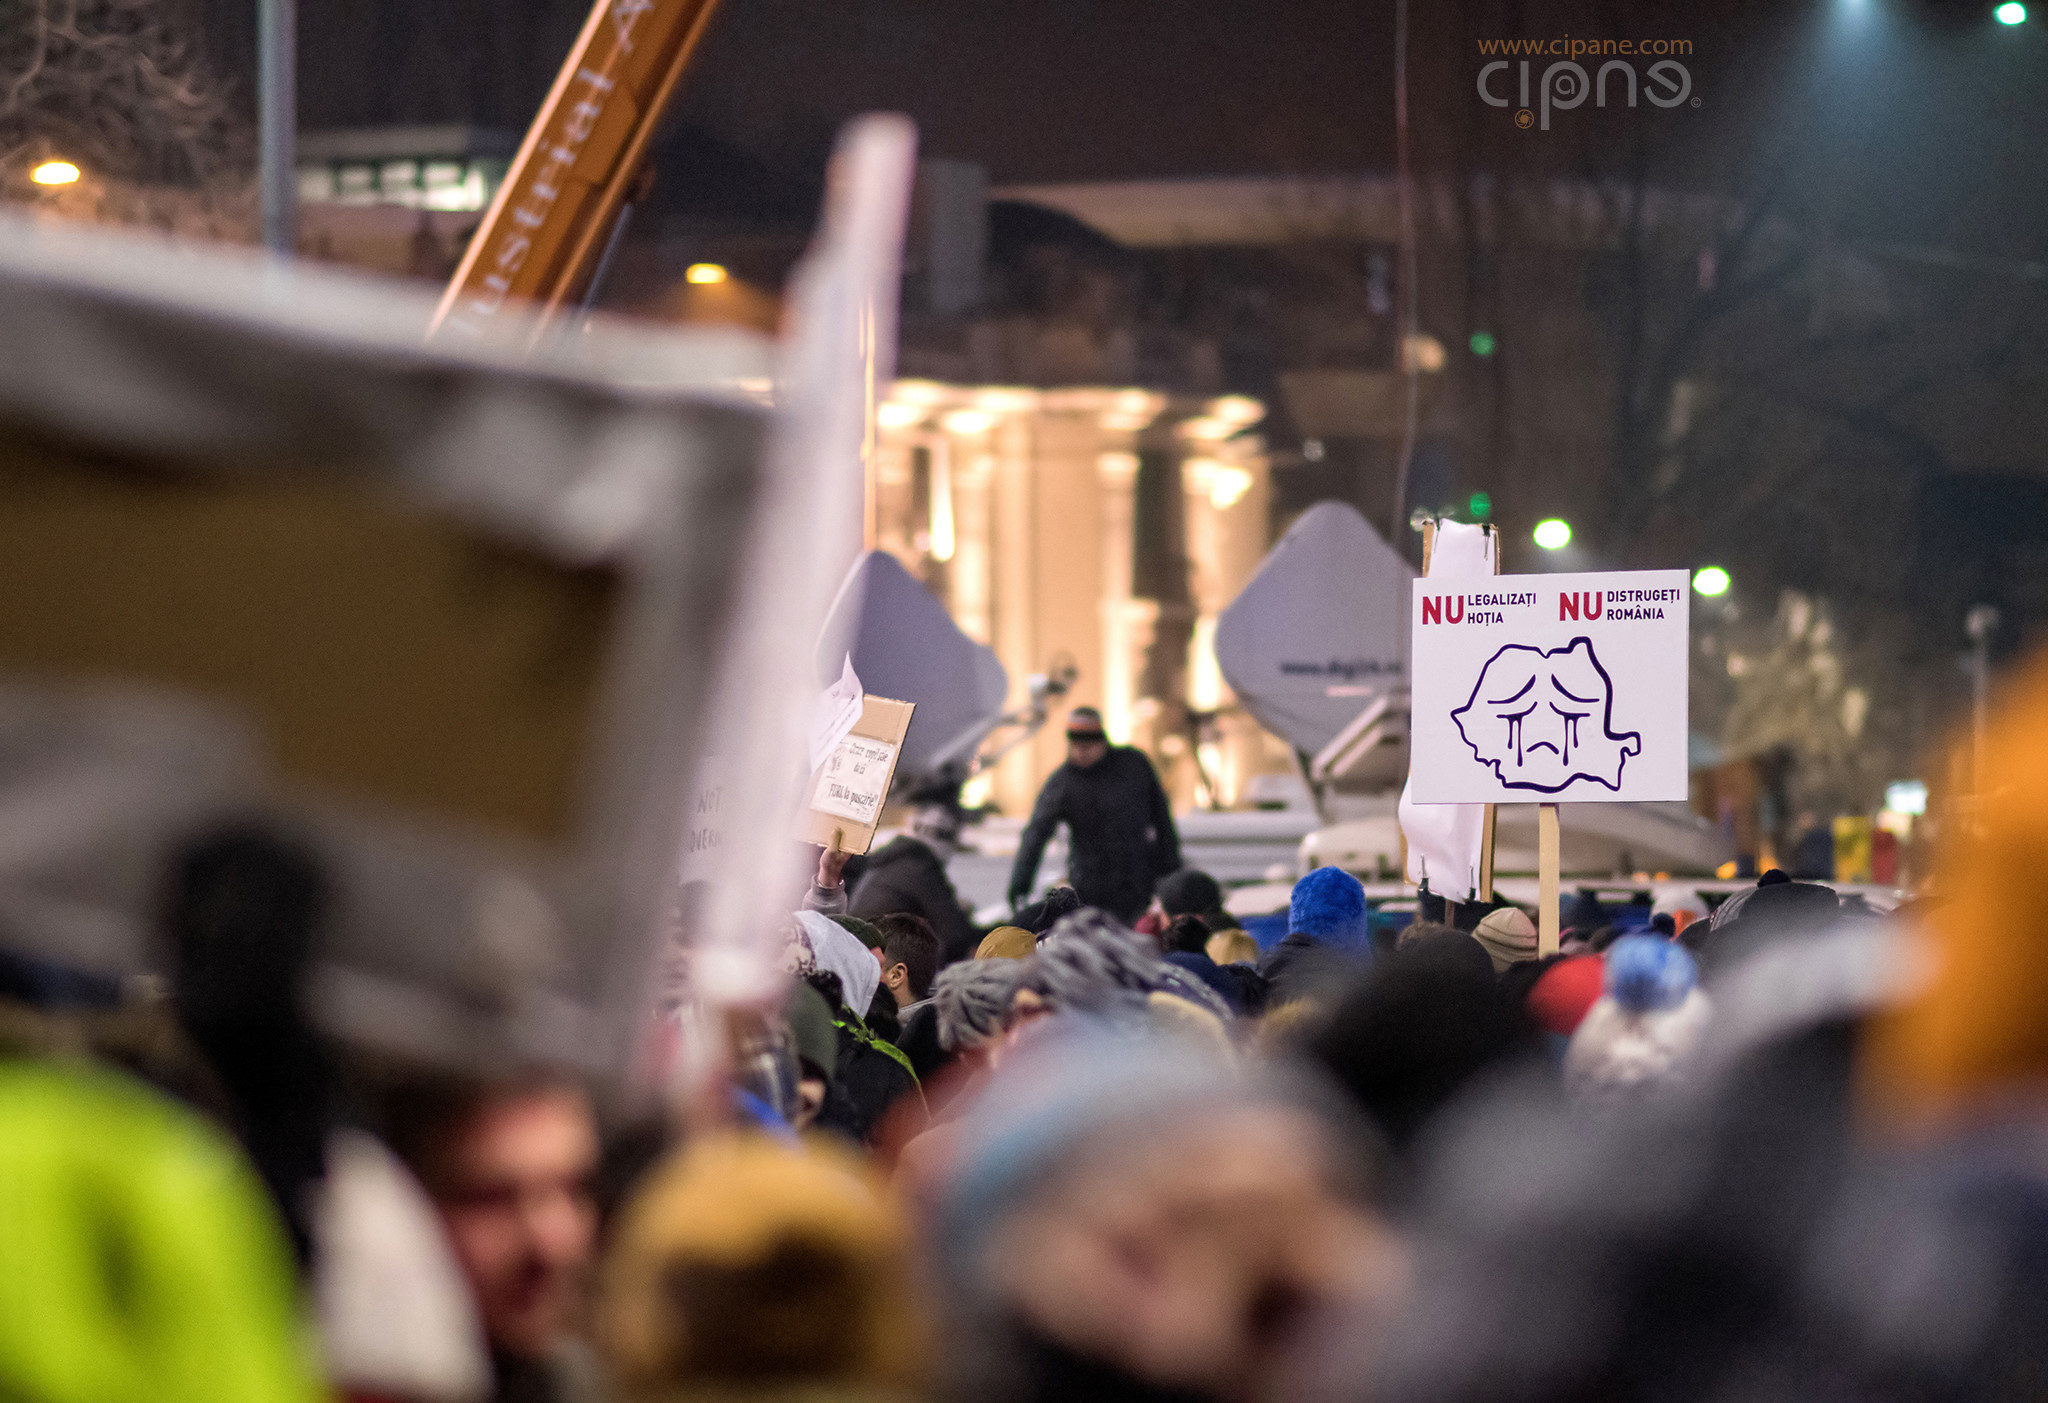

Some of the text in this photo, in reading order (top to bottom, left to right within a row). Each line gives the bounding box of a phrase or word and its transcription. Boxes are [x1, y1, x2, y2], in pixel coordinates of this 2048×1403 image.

[1422, 595, 1465, 625] NU
[1559, 591, 1603, 621] NU
[1606, 604, 1665, 621] ROMÂNIA
